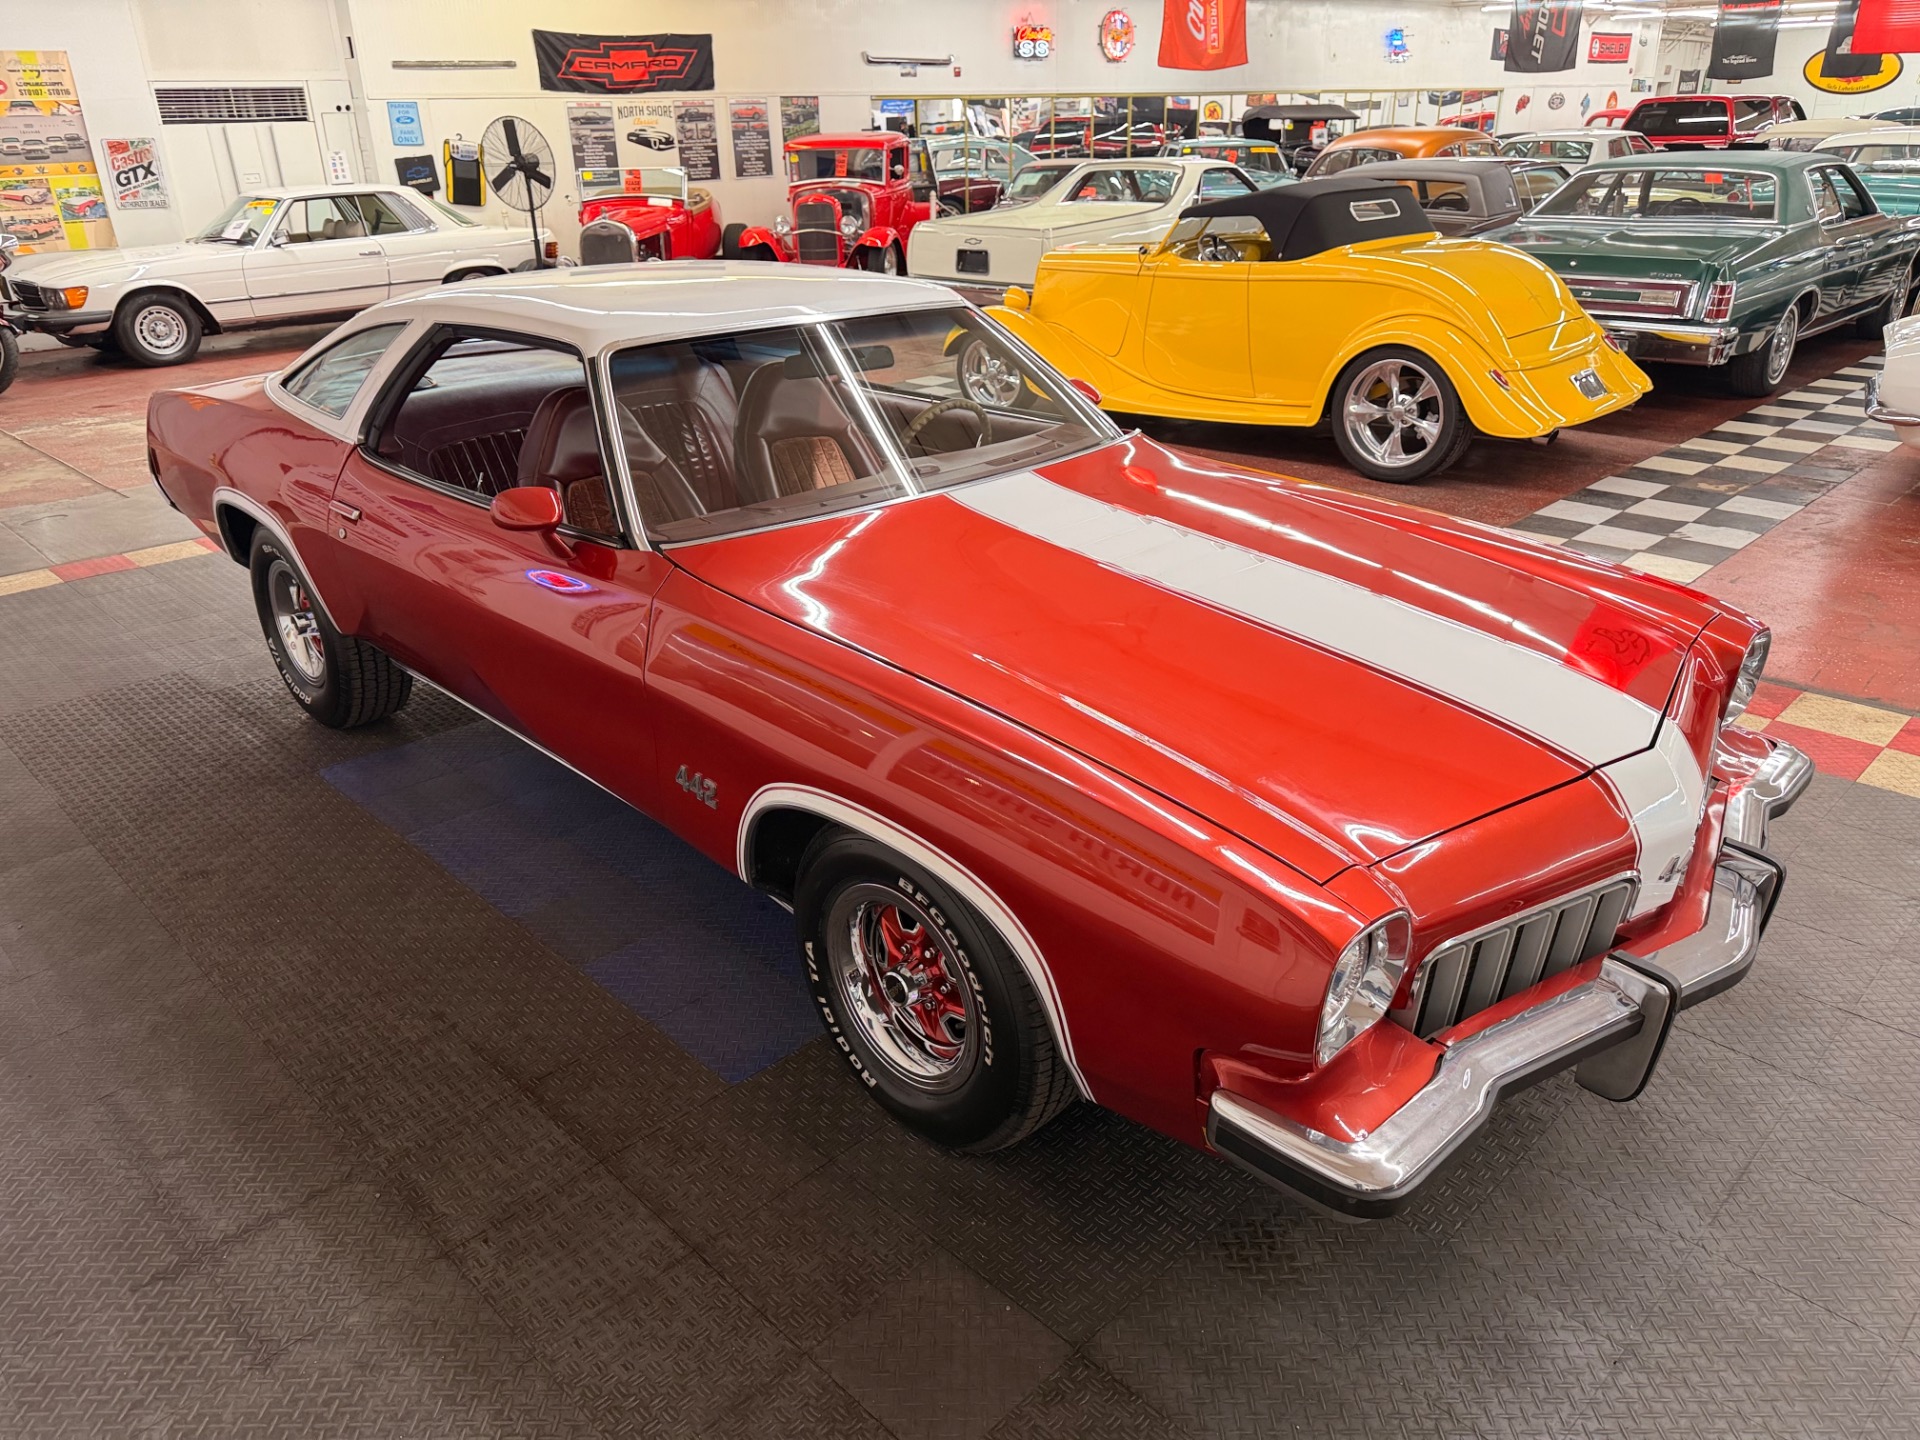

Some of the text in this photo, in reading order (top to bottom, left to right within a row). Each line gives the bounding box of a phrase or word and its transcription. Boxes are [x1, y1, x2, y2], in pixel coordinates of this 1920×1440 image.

[1019, 40, 1049, 57] SS
[1599, 42, 1630, 54] SHELBY
[578, 58, 678, 70] CAMARO
[617, 105, 673, 119] NORTH SHORE
[115, 160, 157, 187] GTX
[281, 669, 313, 705] Radial
[675, 763, 719, 810] 442
[897, 876, 996, 1067] BFGoodrich
[803, 940, 878, 1089] Radial T/A
